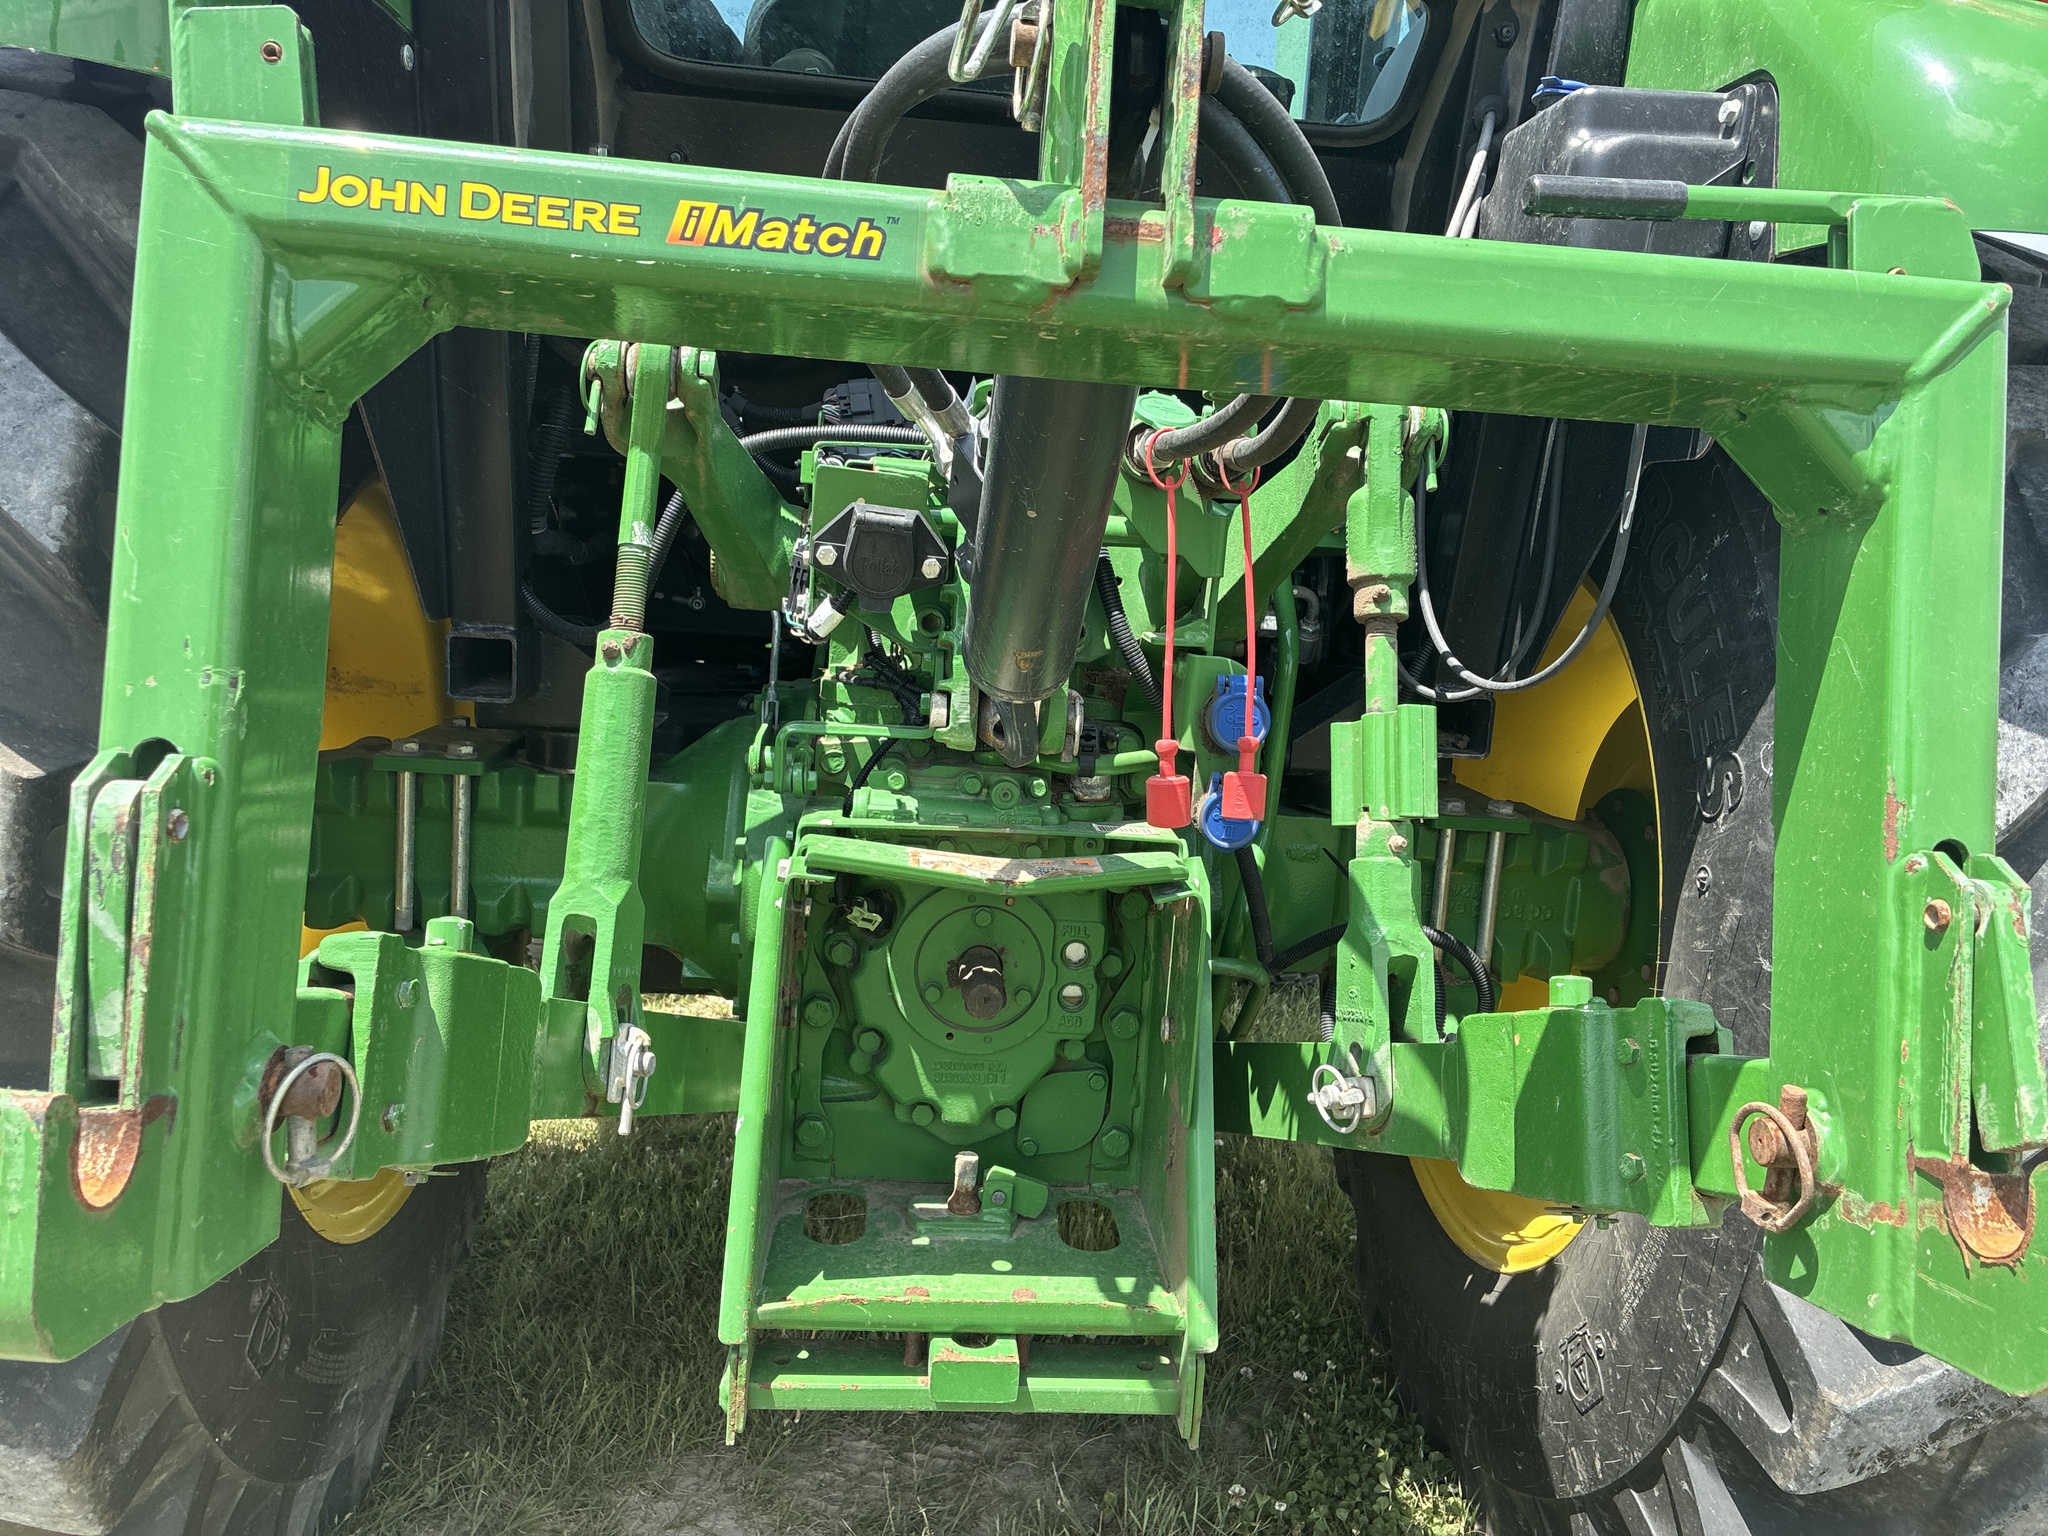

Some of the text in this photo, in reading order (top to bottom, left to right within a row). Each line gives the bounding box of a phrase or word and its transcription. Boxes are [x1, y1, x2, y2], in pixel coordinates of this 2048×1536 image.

[298, 165, 642, 237] JOHN DEERE
[667, 200, 887, 260] iMatch
[861, 554, 900, 576] Pollak
[1060, 925, 1090, 939] FULL
[1058, 1014, 1083, 1028] ADD
